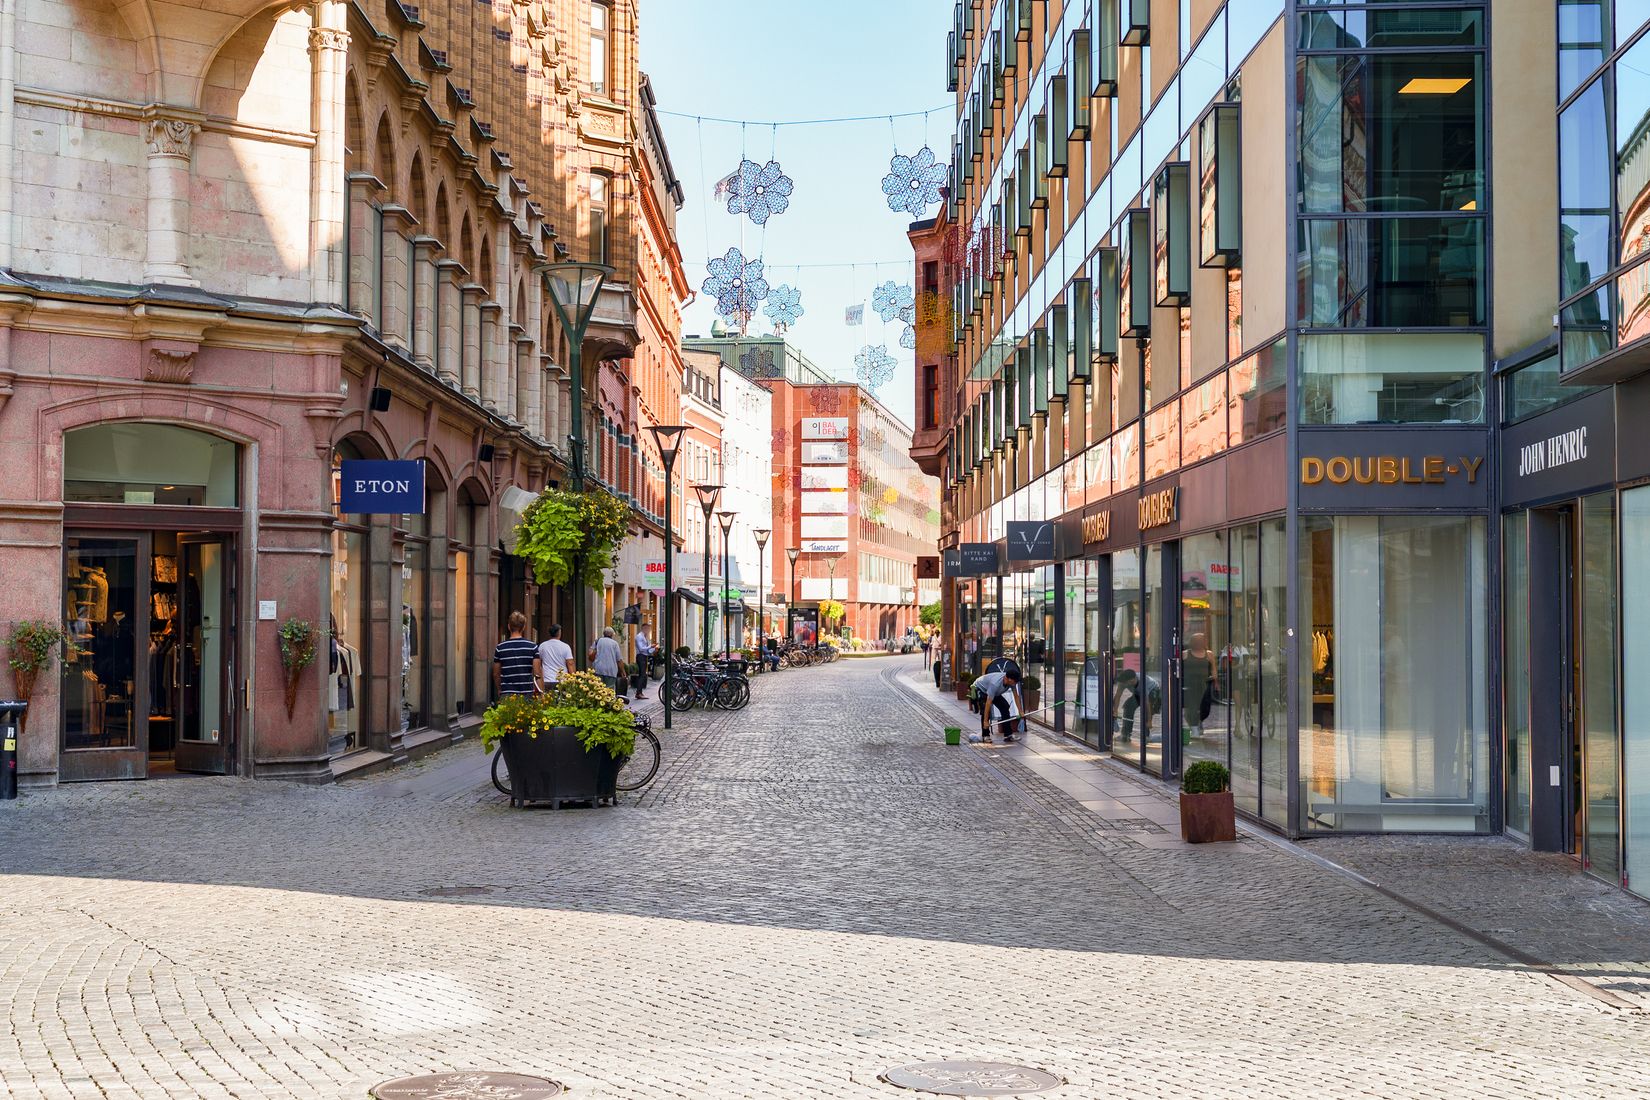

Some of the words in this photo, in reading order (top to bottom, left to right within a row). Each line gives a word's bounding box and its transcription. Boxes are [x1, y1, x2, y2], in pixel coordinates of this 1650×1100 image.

[1519, 442, 1545, 477] JOHN
[1547, 426, 1587, 469] HENRIC
[1301, 455, 1484, 484] DOUBLE-Y
[354, 480, 410, 494] ETON
